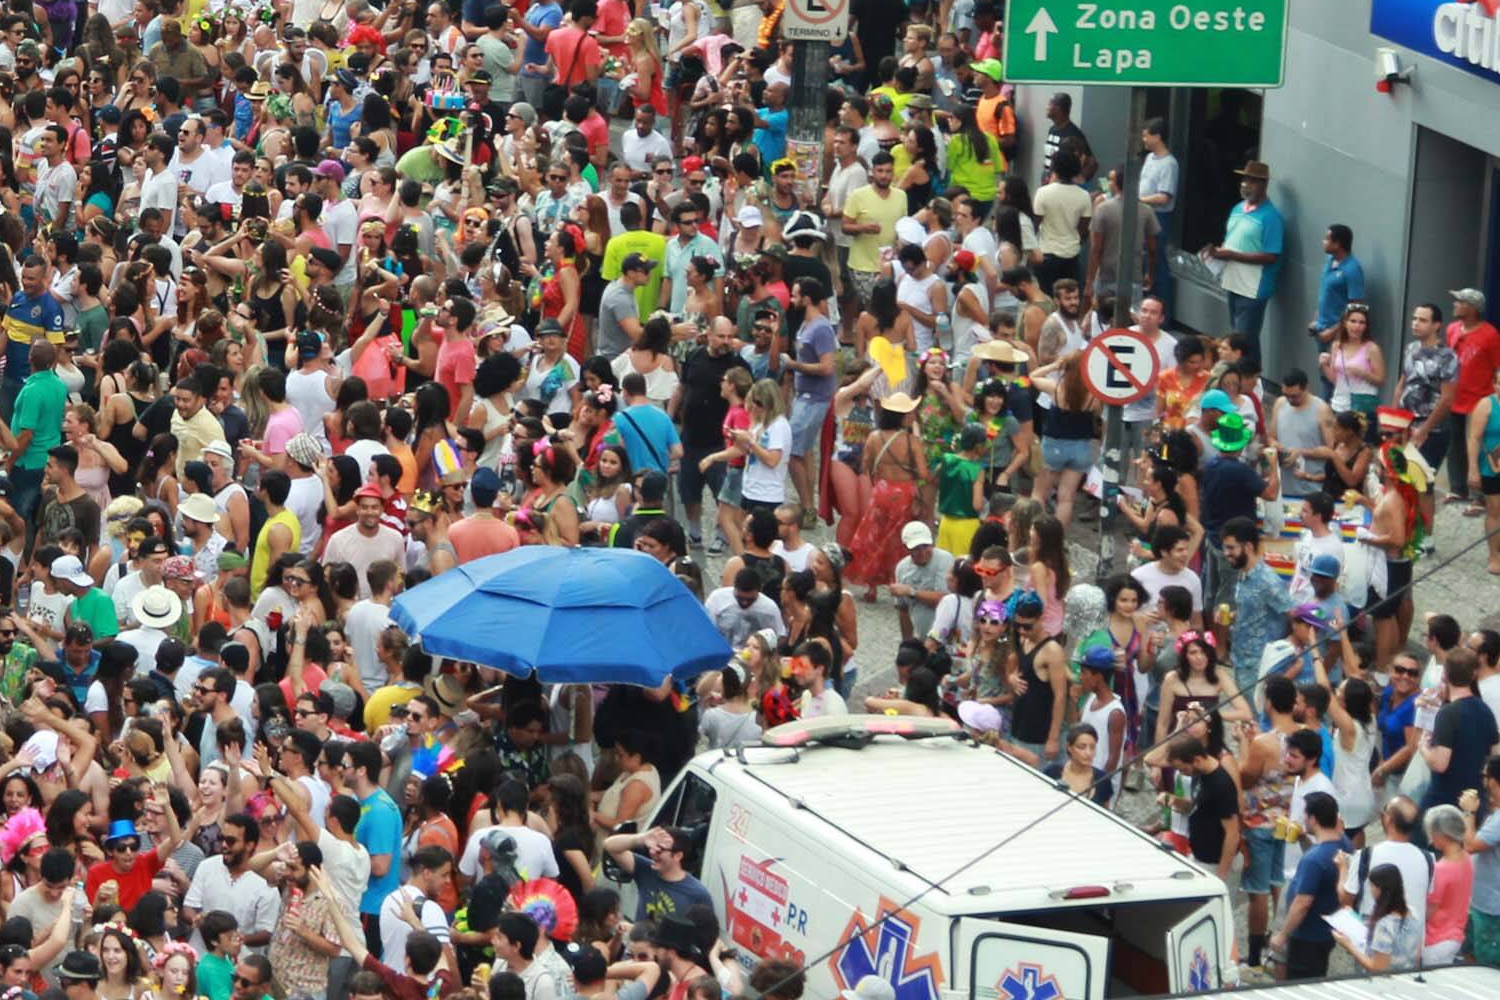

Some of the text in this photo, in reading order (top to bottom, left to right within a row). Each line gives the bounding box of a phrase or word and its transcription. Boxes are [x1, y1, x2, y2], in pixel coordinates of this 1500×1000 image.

[1075, 3, 1266, 31] Zona Oeste
[1073, 43, 1152, 75] Lapa
